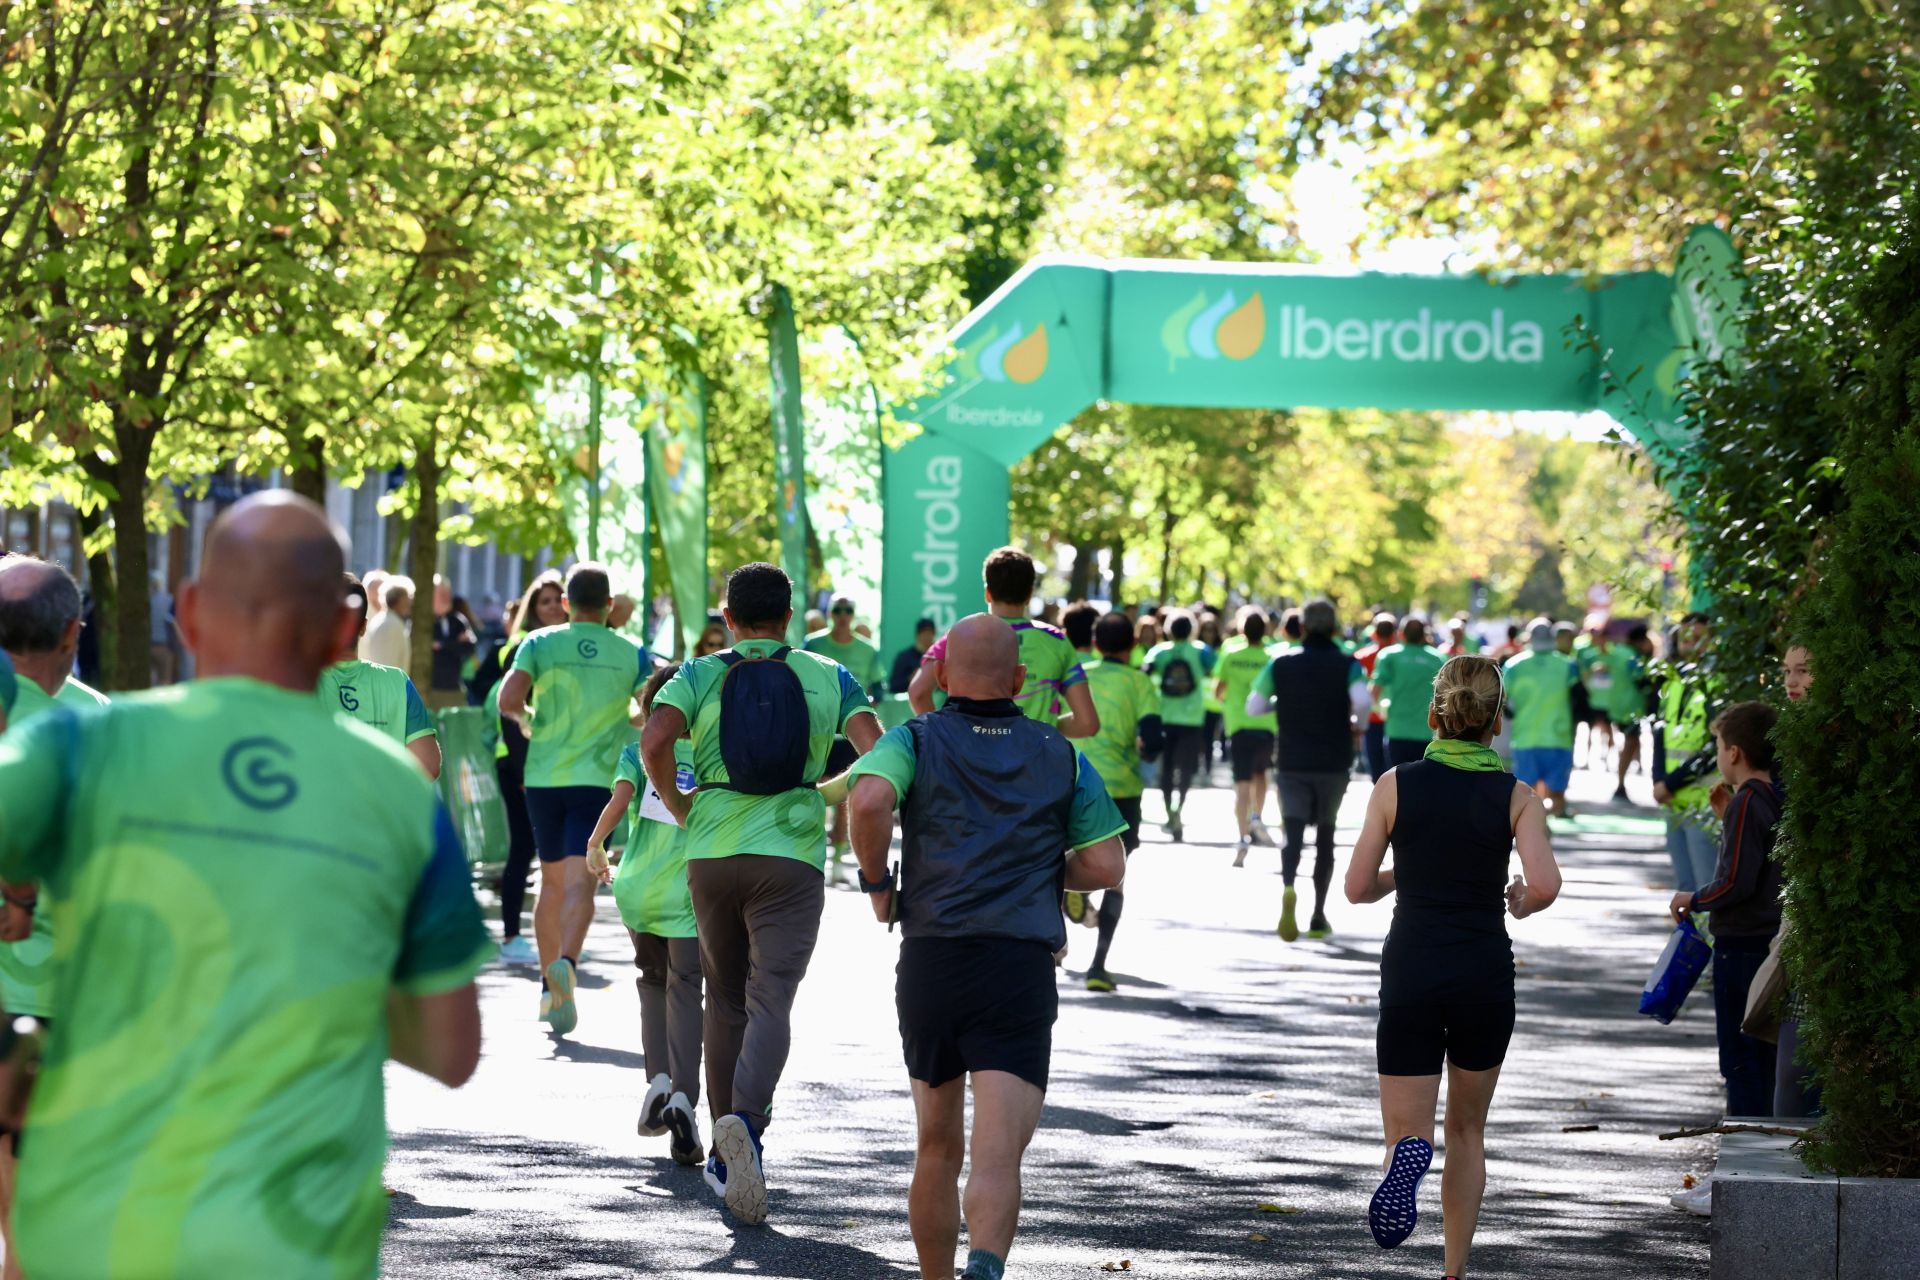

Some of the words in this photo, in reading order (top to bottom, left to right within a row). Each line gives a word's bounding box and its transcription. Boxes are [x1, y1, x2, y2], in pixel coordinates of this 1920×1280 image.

[1280, 304, 1544, 363] Iberdrola
[947, 403, 1044, 427] Iberdrola
[913, 455, 963, 637] erdrola
